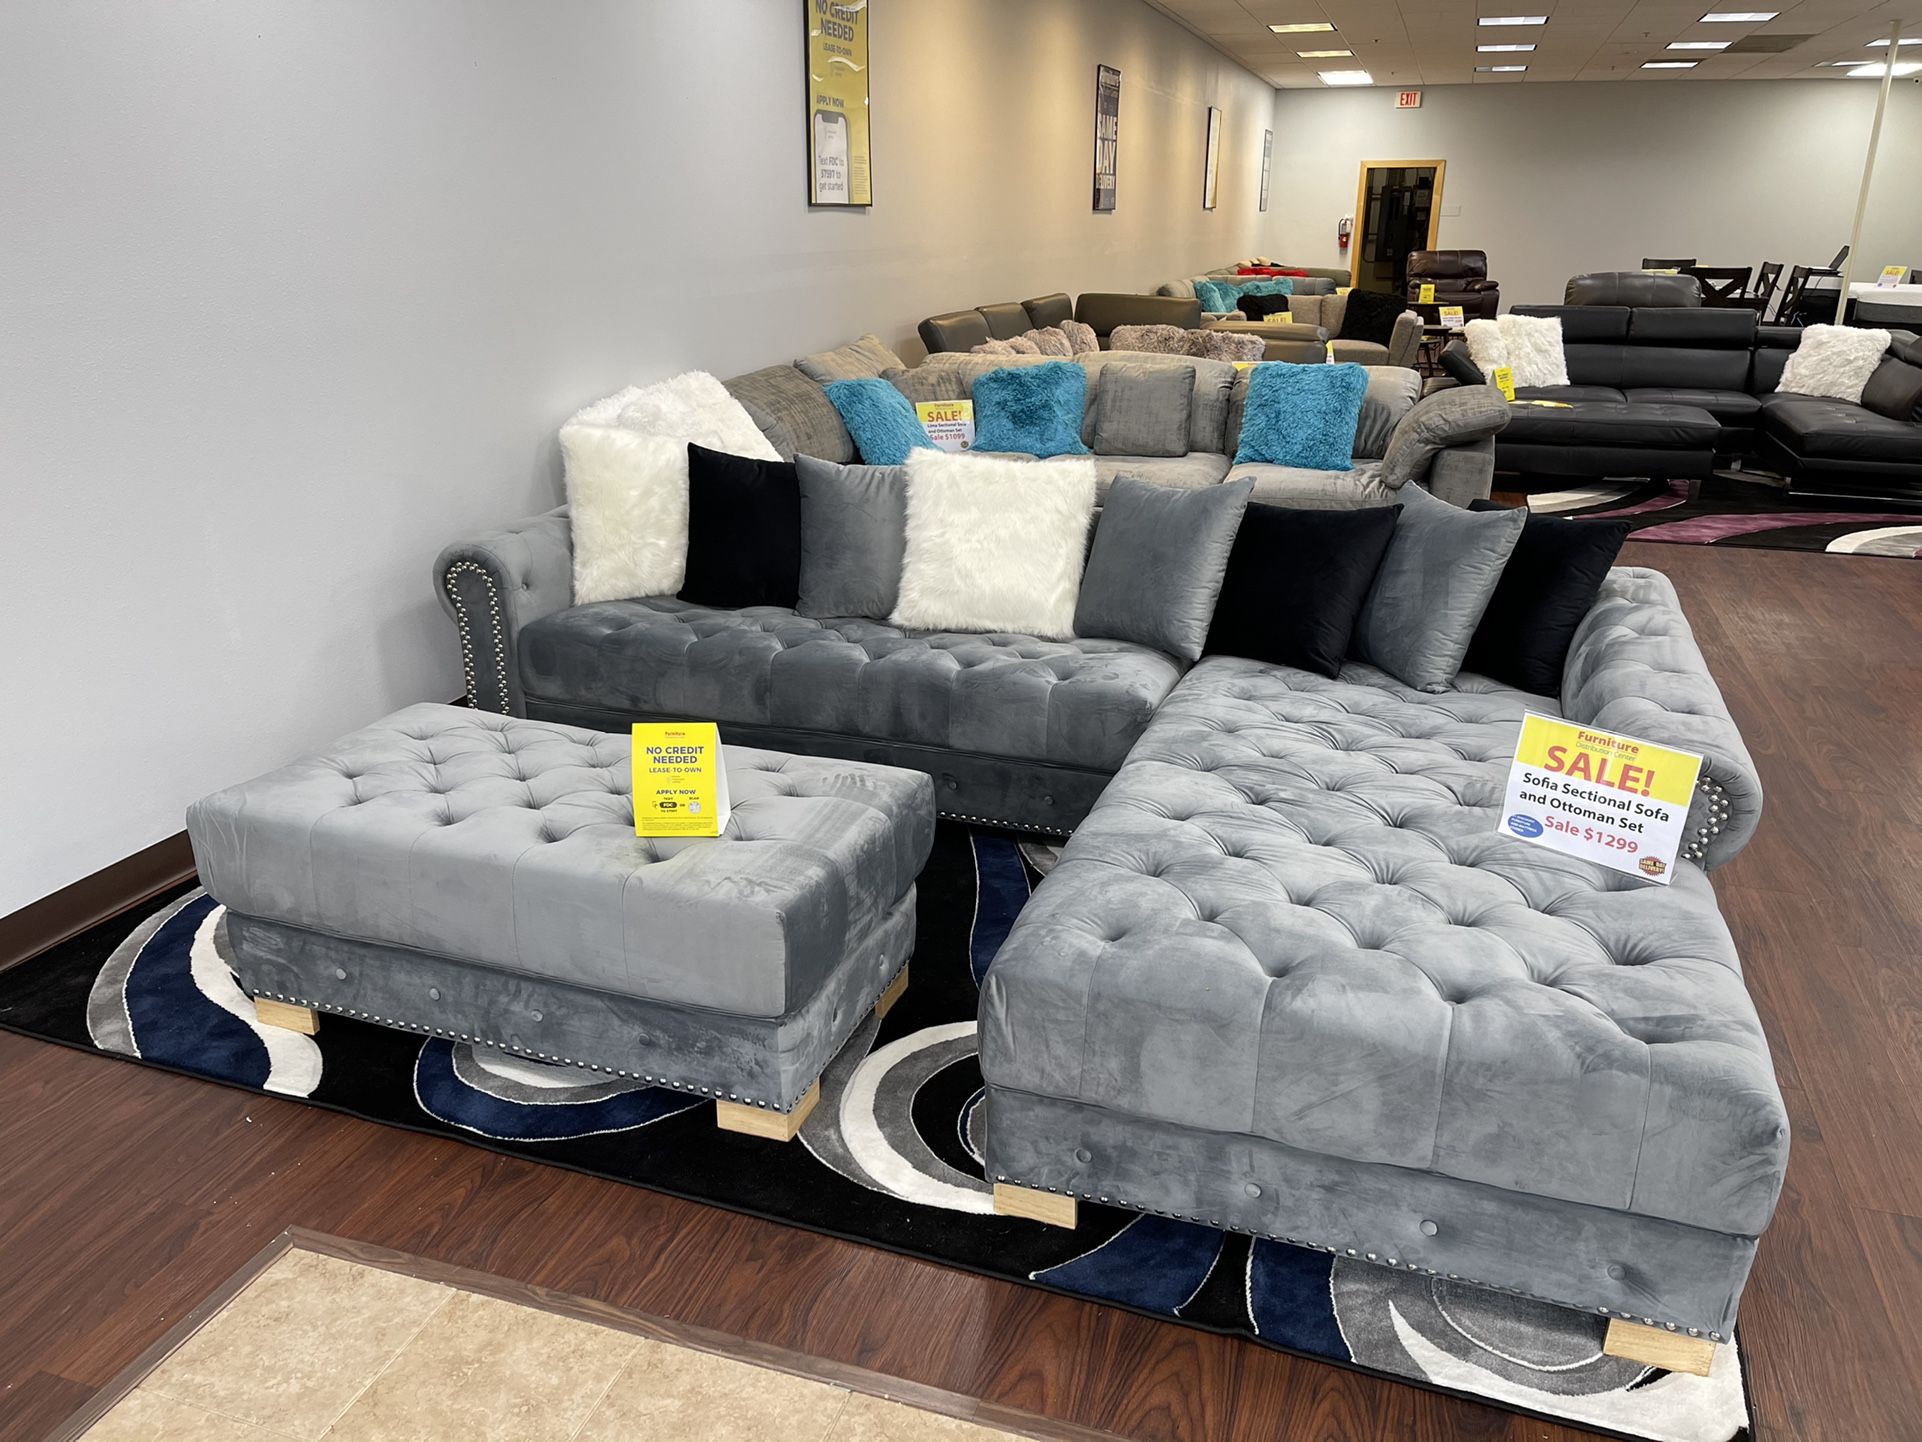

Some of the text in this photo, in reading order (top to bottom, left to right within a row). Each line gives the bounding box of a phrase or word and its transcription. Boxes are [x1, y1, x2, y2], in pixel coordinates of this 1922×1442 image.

[816, 0, 859, 25] NO CREDIT
[820, 17, 855, 42] NEEDED
[816, 95, 831, 107] APPLY
[1400, 92, 1418, 106] EXIT
[1097, 138, 1116, 174] DAY
[927, 411, 962, 422] SALE!
[646, 746, 704, 755] NO CREDIT
[1577, 731, 1640, 754] Furniture
[653, 755, 698, 764] NEEDED
[1543, 745, 1656, 797] SALE!
[1522, 772, 1670, 823] Sofia Sectional Sofa
[1519, 790, 1547, 806] and
[1549, 797, 1615, 826] Ottoman
[1618, 817, 1645, 834] Set
[1544, 815, 1580, 837] Sale
[1583, 827, 1639, 855] $1299
